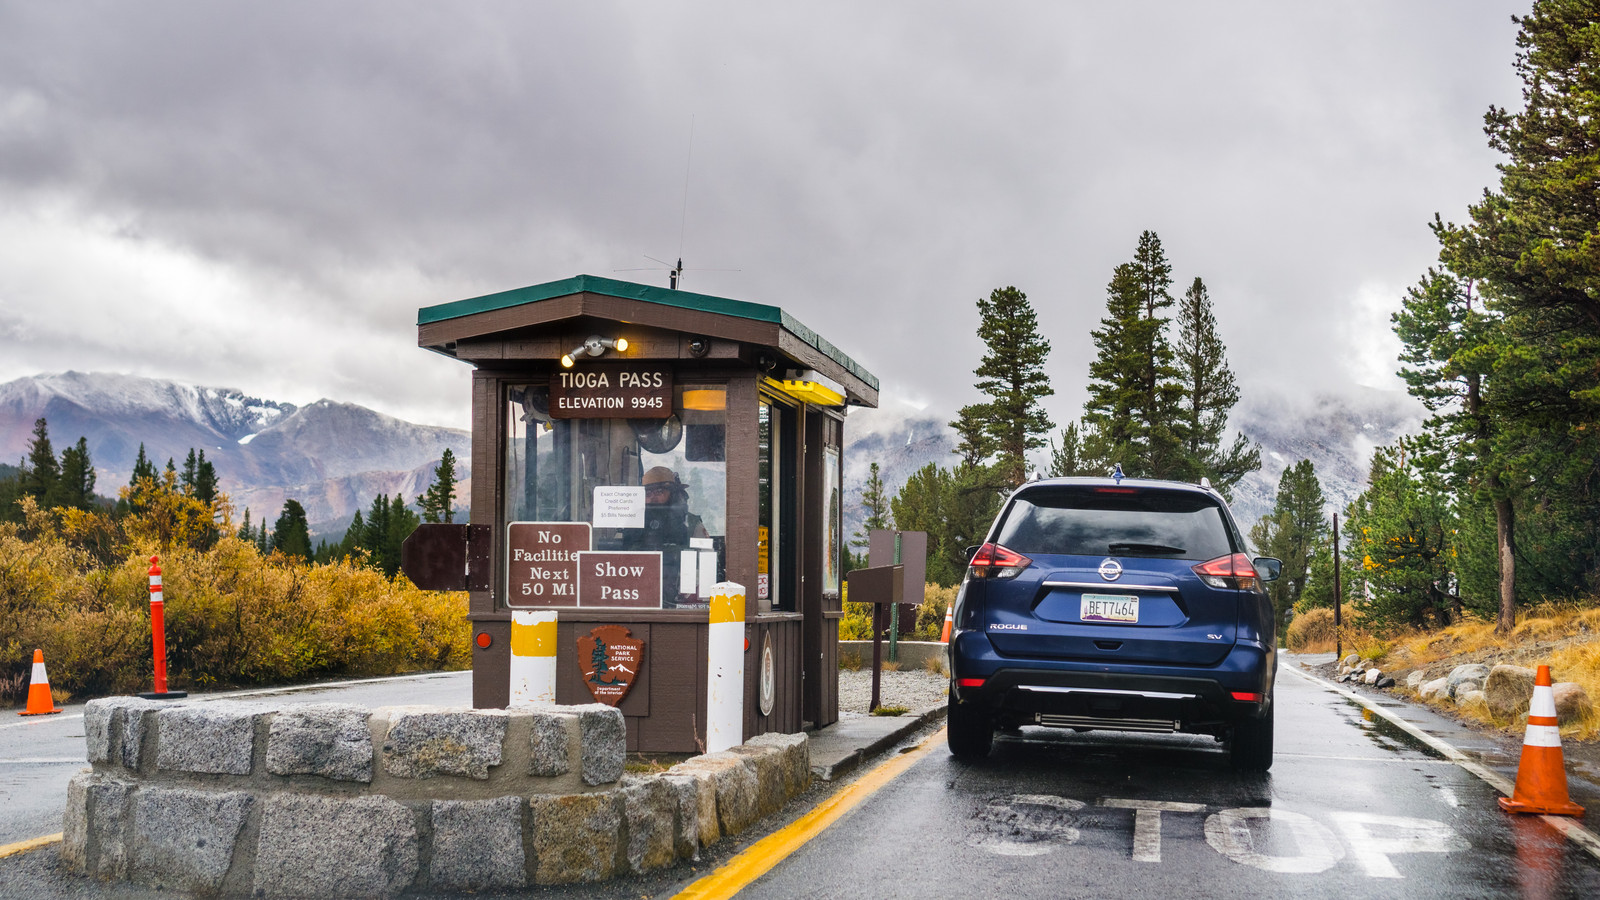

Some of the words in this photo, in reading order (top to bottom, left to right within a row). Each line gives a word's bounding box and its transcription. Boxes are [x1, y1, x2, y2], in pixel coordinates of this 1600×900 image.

[559, 372, 609, 388] TIOGA
[619, 372, 663, 388] PASS
[559, 397, 624, 409] ELEVATION
[631, 397, 663, 409] 9945
[538, 530, 562, 544] No
[513, 548, 578, 562] Facilitie
[530, 567, 569, 580] Next
[595, 562, 645, 577] Show
[522, 583, 544, 596] 50
[552, 583, 575, 596] Mi
[601, 586, 640, 600] Pass
[1089, 601, 1134, 616] BET7464
[966, 794, 1472, 879] STOP
